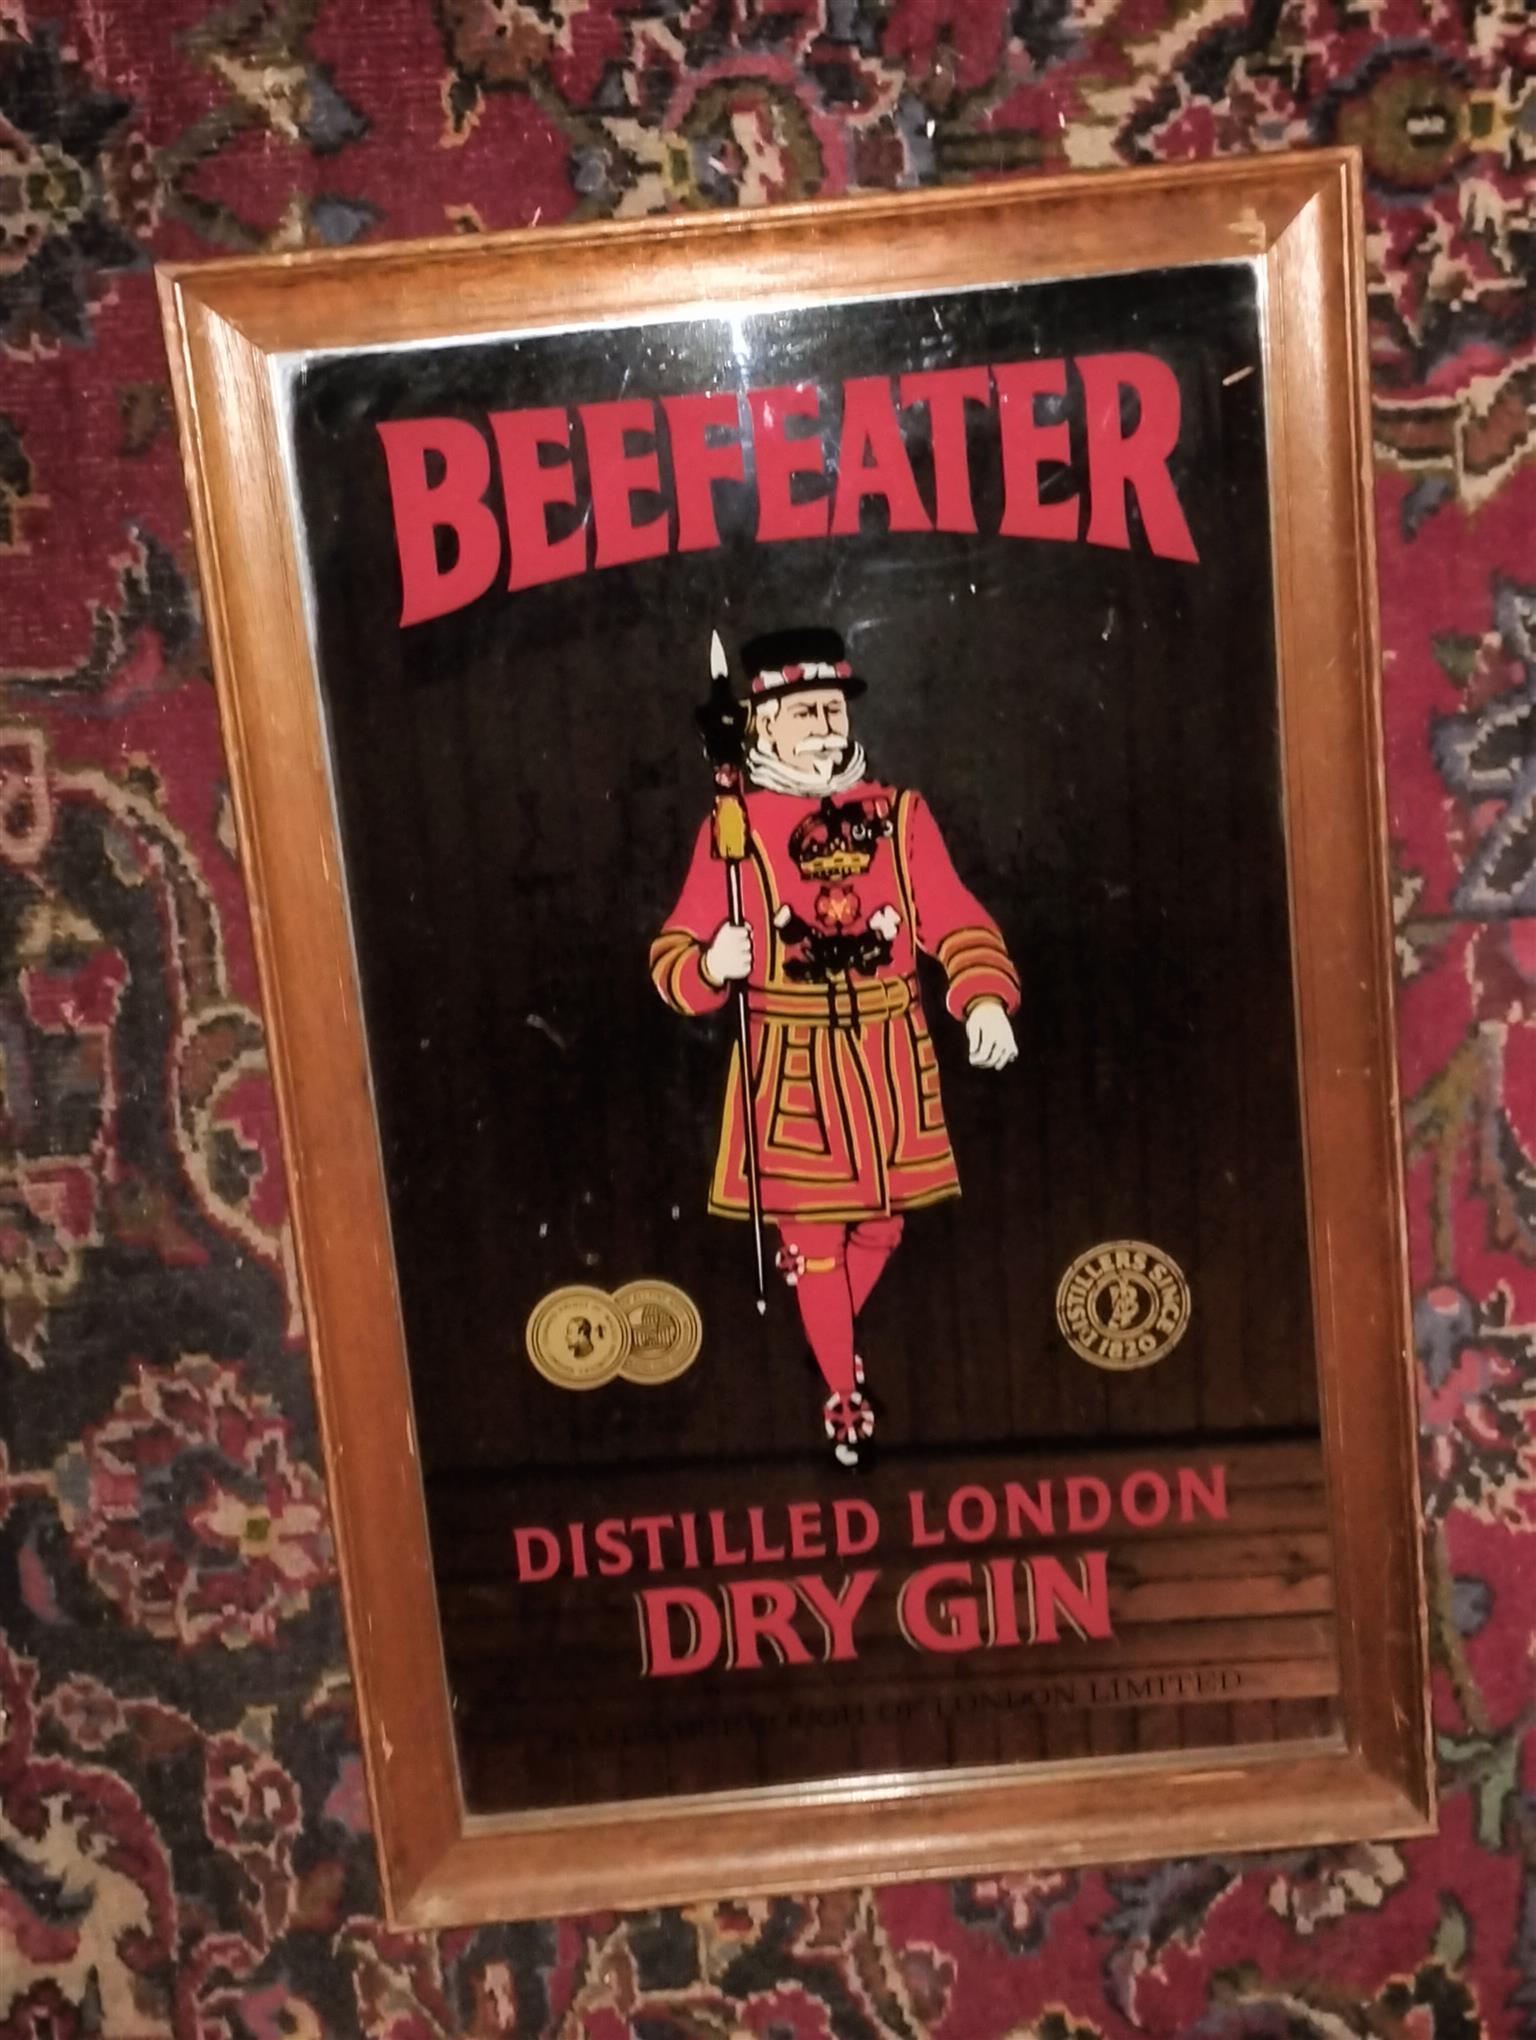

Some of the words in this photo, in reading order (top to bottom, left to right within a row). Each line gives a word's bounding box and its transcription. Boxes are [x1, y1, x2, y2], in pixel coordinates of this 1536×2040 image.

[375, 351, 1199, 628] BEEFEATER
[512, 1499, 880, 1582] DISTILLED
[908, 1465, 1229, 1548] LONDON
[634, 1570, 880, 1678] DRY
[897, 1551, 1115, 1653] GIN
[936, 1682, 1076, 1718] LONDON
[1090, 1669, 1244, 1703] LIMITED
